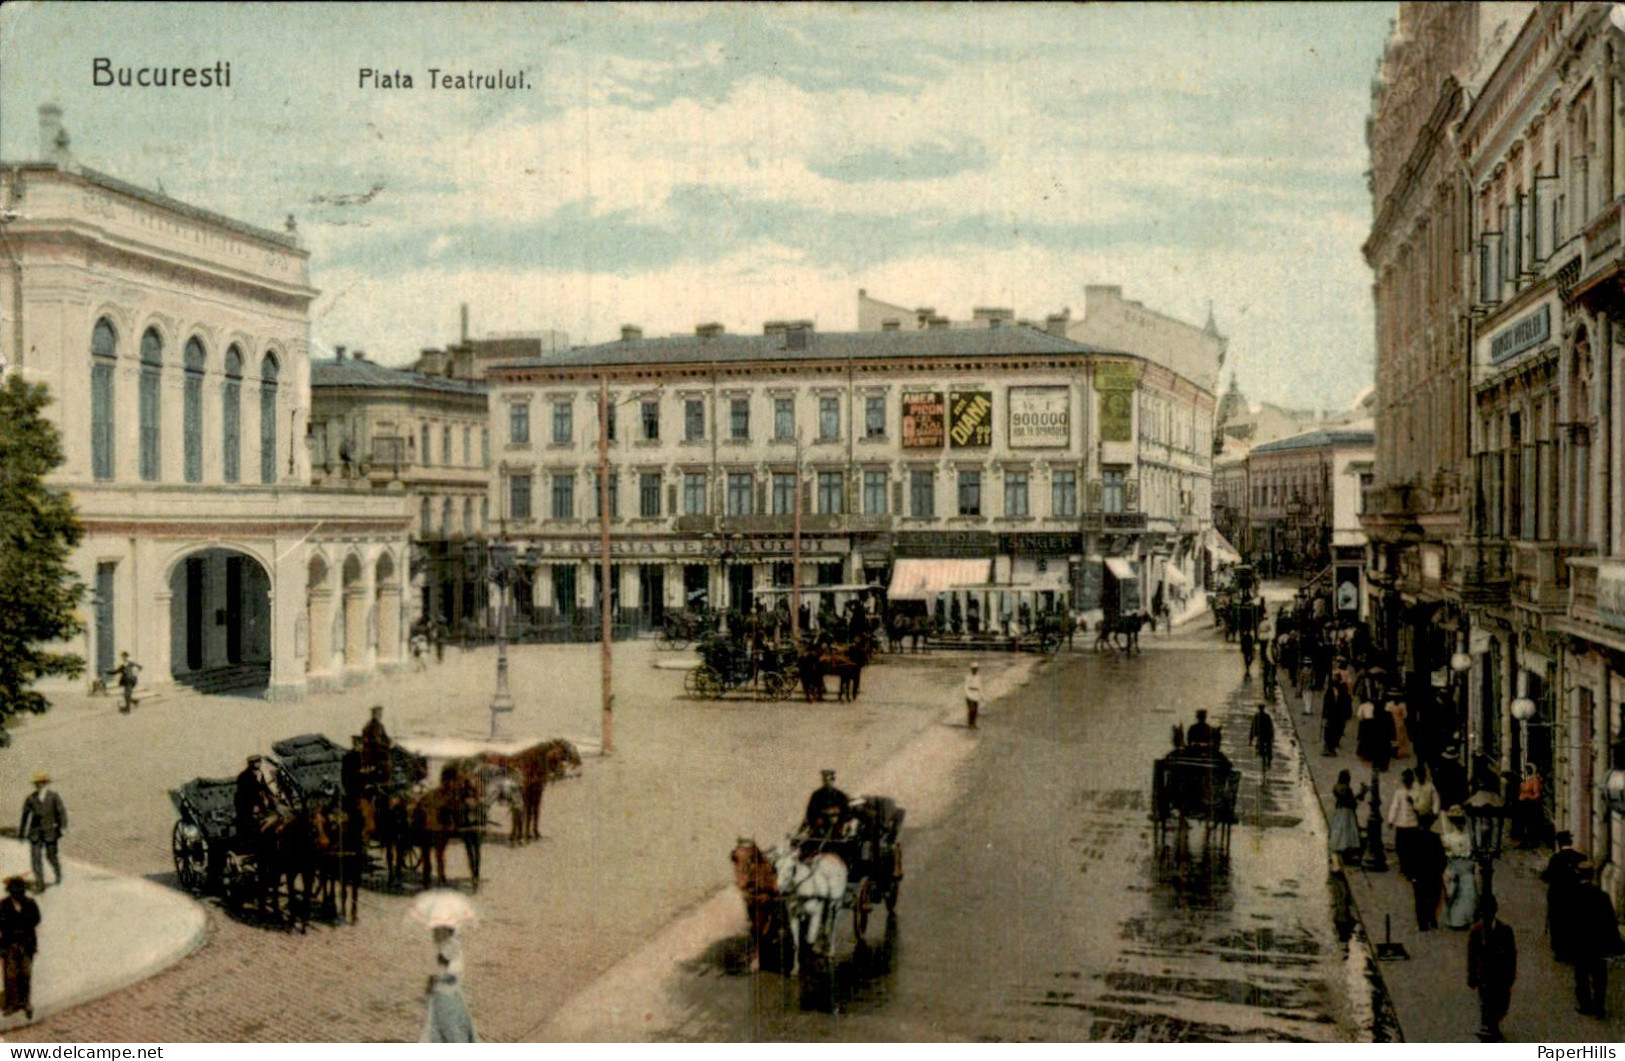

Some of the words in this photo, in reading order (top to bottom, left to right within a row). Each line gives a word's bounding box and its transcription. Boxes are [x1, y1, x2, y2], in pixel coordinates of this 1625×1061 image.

[951, 395, 991, 446] DIANA
[1012, 412, 1068, 426] 900000
[1007, 536, 1073, 550] SINGER
